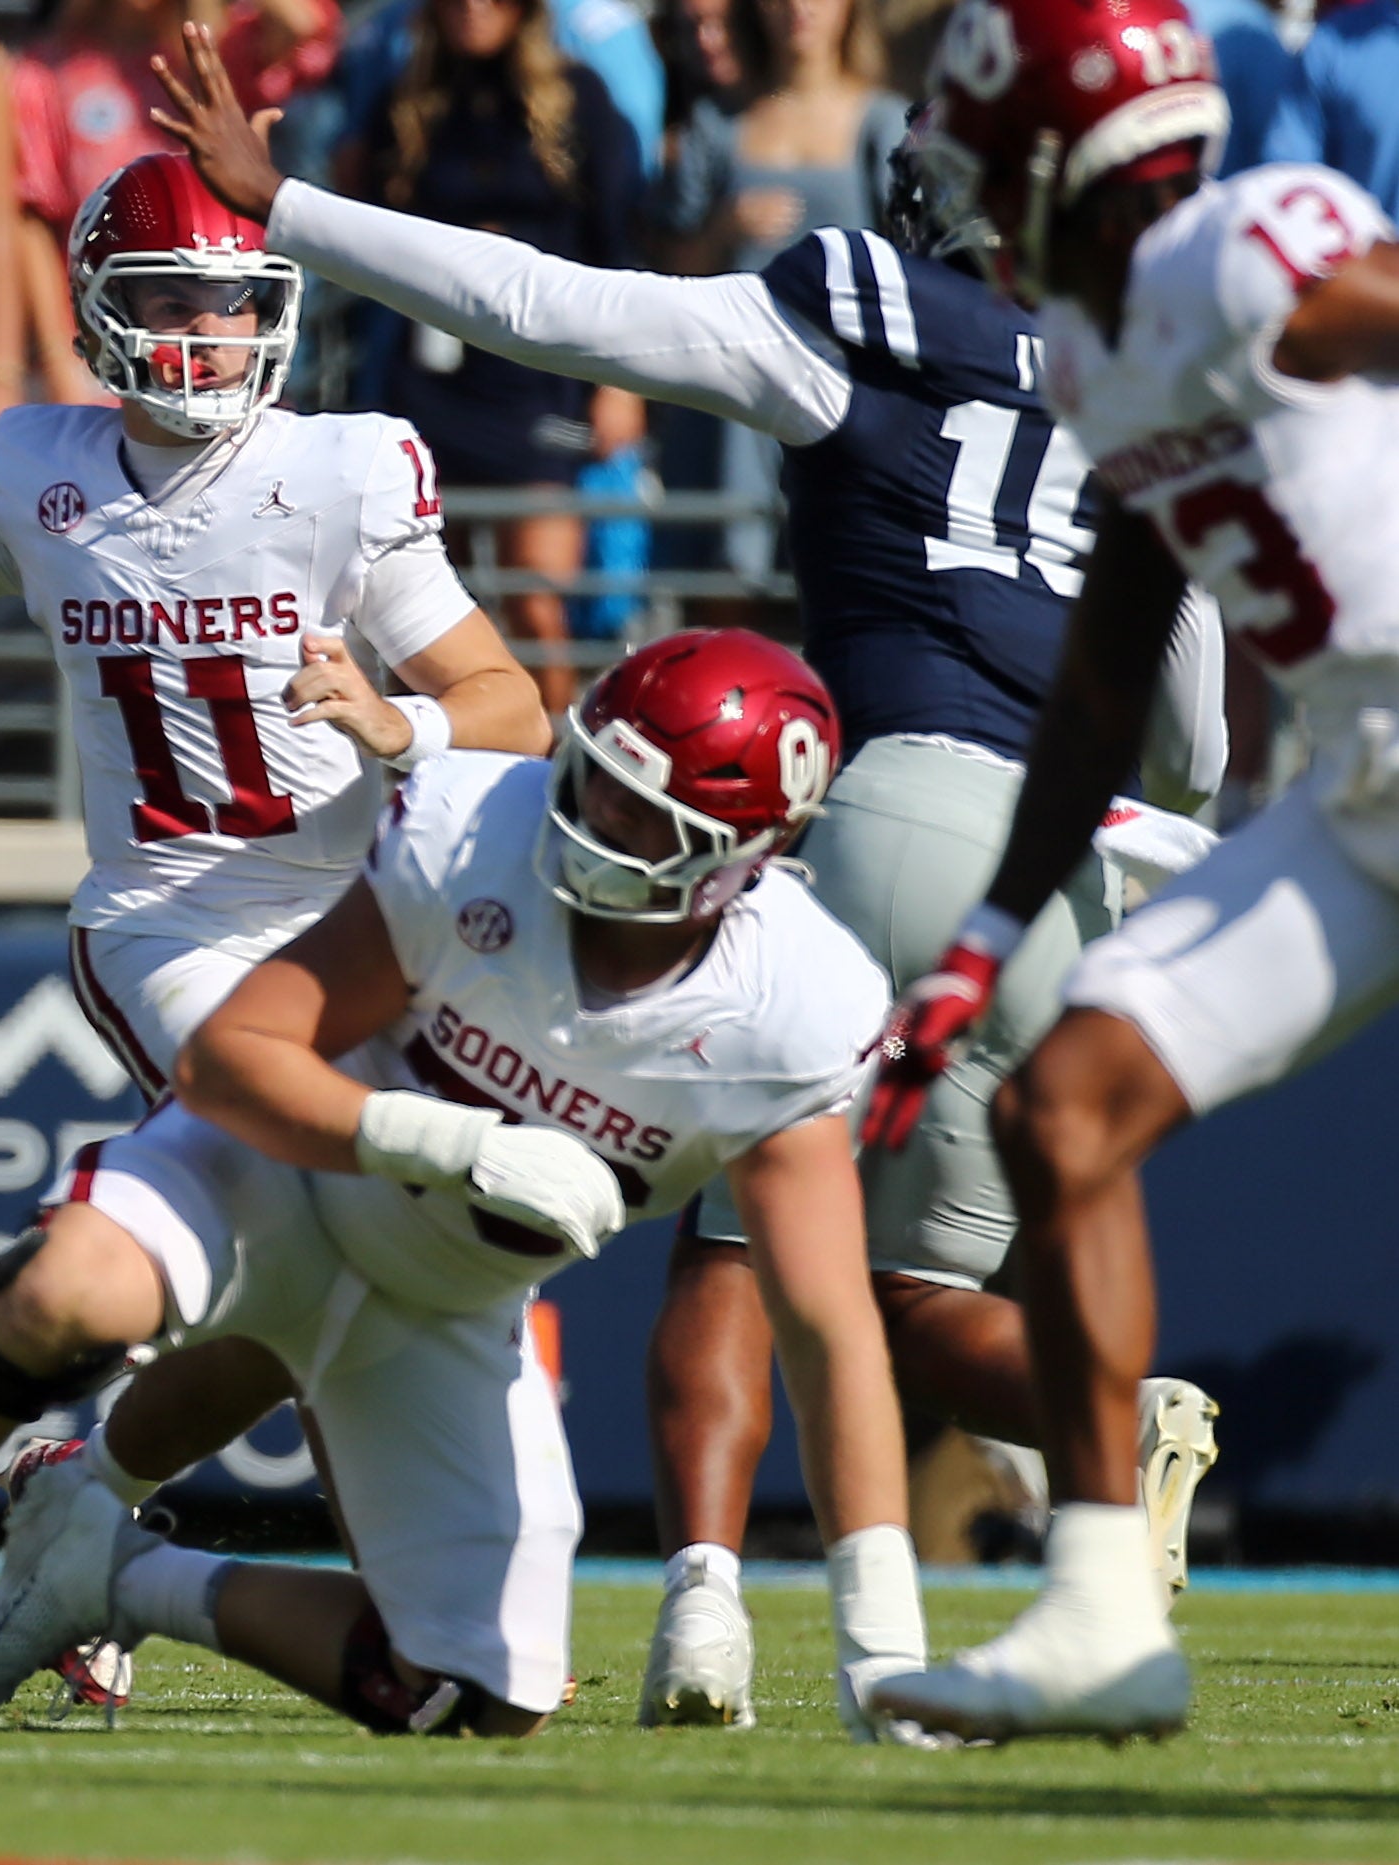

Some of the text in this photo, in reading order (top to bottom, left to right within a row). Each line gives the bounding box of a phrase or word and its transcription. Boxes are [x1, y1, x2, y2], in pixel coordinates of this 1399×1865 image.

[38, 482, 86, 533] SEC
[1157, 474, 1336, 667] 3
[62, 592, 299, 646] SOONERS
[97, 654, 297, 853] 11
[431, 1002, 673, 1162] SOONERS
